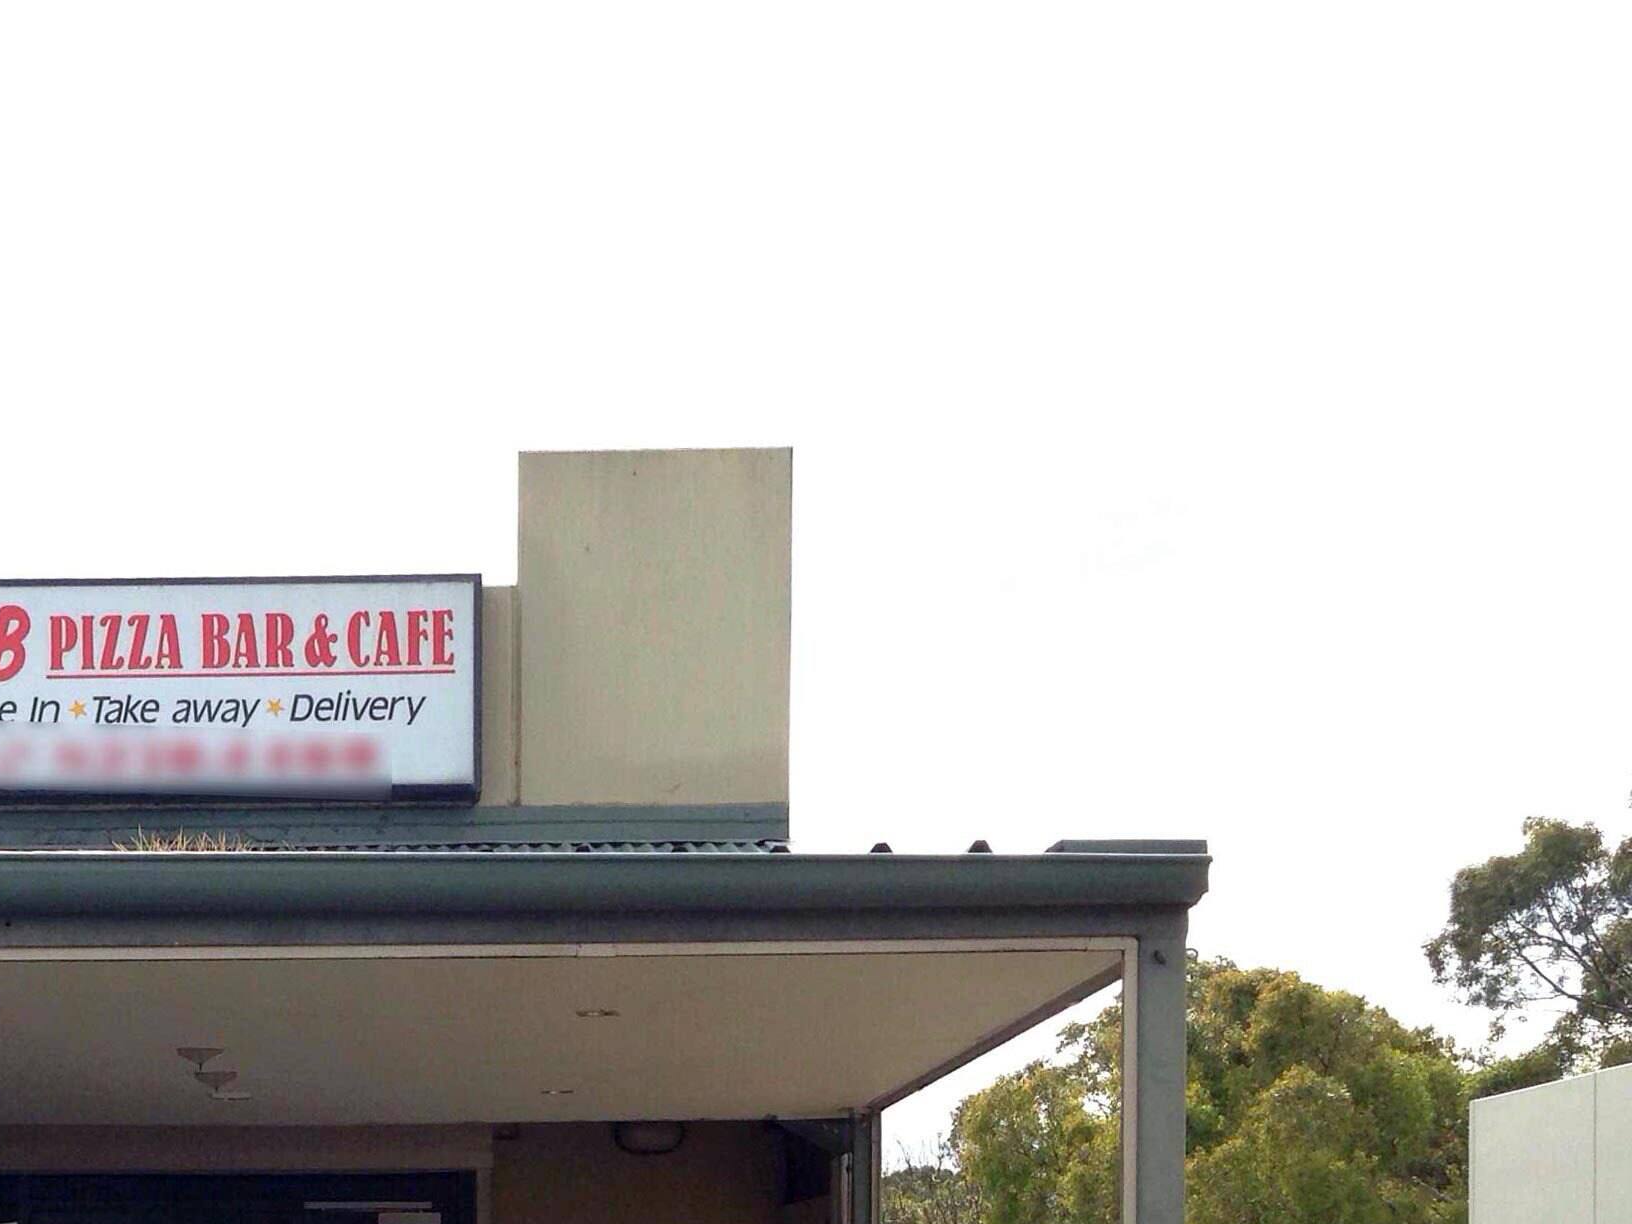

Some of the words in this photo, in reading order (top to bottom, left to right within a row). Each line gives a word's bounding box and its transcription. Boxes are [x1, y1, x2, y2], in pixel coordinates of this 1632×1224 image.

[50, 614, 183, 670] PIZZA
[201, 612, 295, 669] BAR
[347, 610, 454, 667] CAFE
[29, 696, 60, 725] In
[92, 695, 160, 725] Take
[172, 698, 261, 727] away
[289, 690, 426, 725] Delivery
